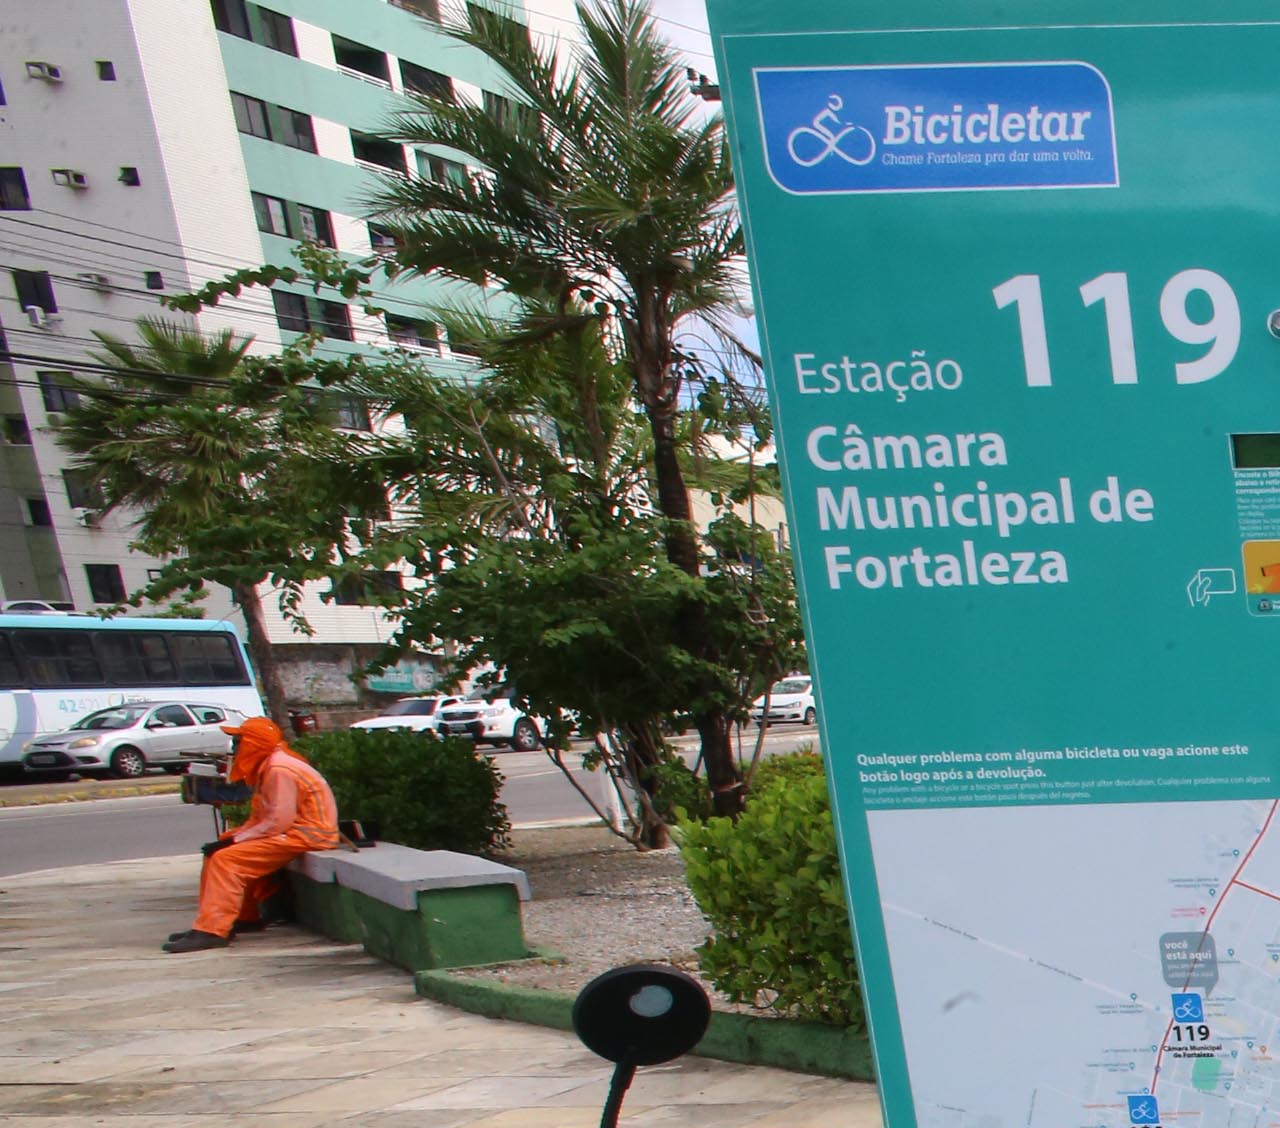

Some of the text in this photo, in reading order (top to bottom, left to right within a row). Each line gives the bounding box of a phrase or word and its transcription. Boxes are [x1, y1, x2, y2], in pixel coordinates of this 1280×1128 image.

[883, 104, 1091, 145] Bicicletar
[881, 148, 1094, 166] Chame Fortaleza pra dar uma volta.
[794, 269, 1241, 402] Estação 119
[806, 425, 1008, 472] Câmara
[816, 476, 1154, 538] Municipal de
[823, 544, 1069, 590] Fortaleza
[856, 743, 1249, 767] Qualquer problema com alguma bicicleta ou vaga acione este
[859, 765, 1046, 784] botão logo após a devolução.
[1165, 940, 1188, 950] você
[1166, 950, 1212, 960] está aqui
[1173, 1025, 1210, 1042] 119
